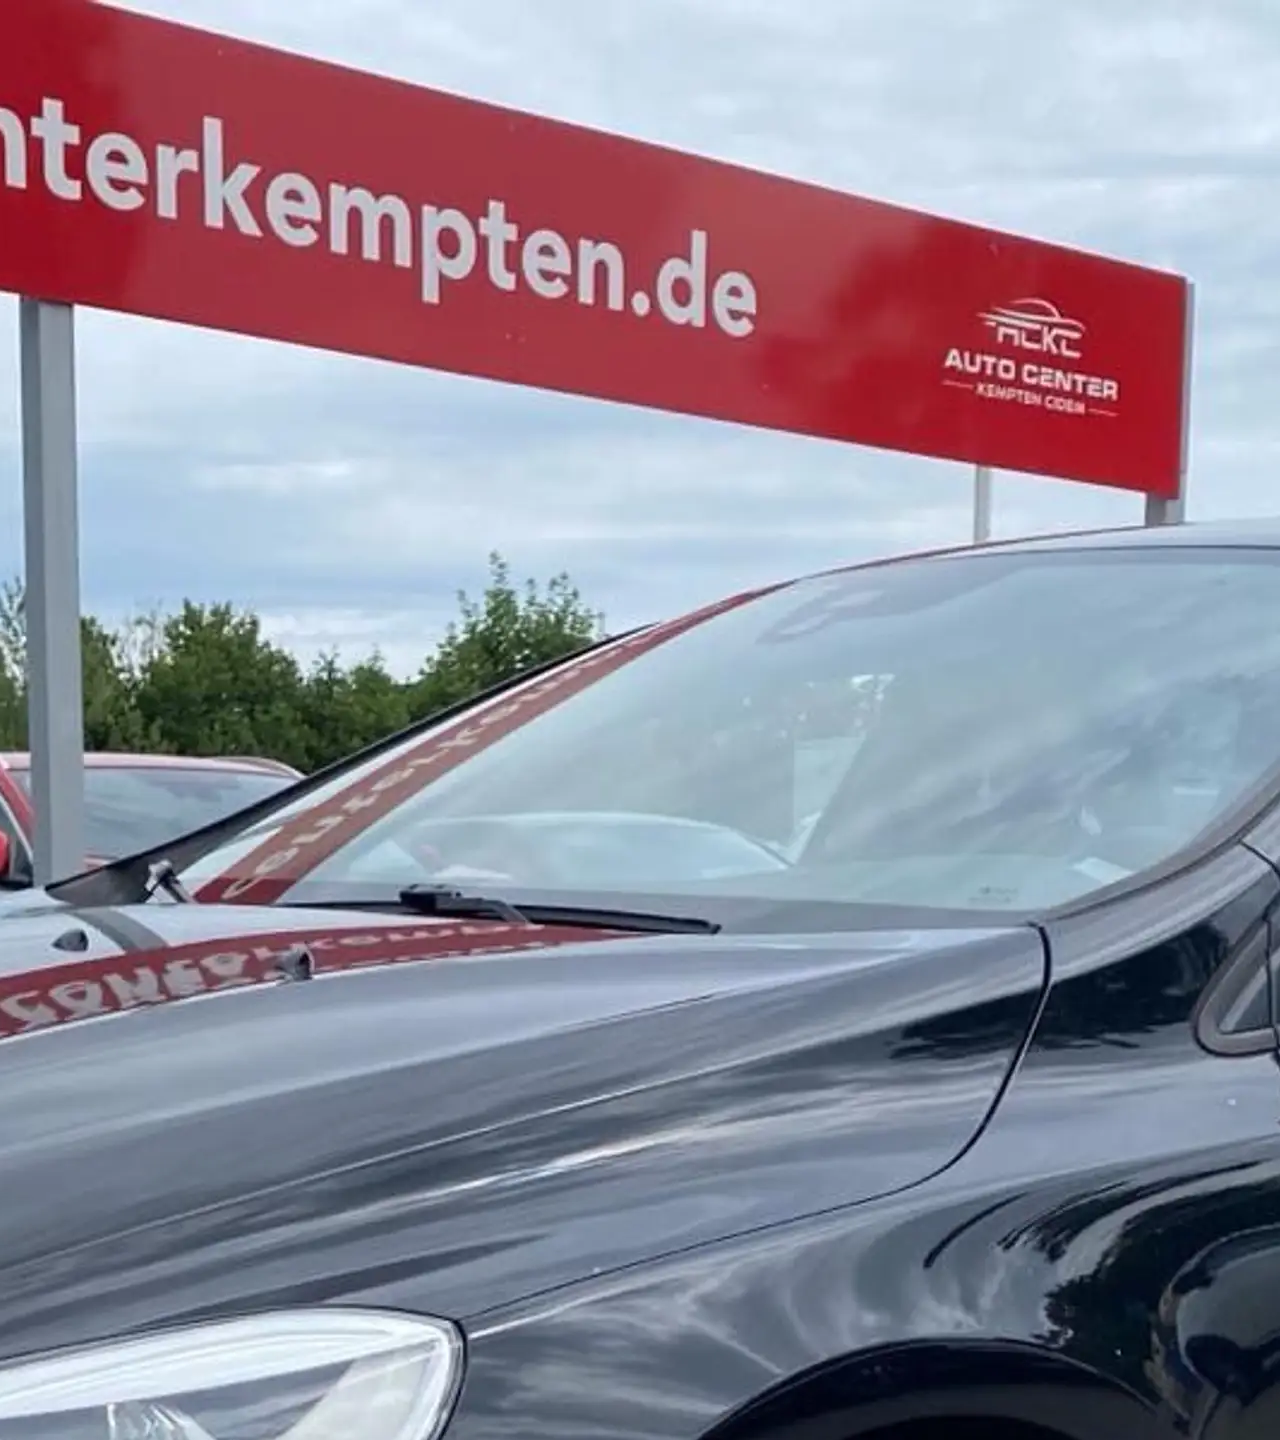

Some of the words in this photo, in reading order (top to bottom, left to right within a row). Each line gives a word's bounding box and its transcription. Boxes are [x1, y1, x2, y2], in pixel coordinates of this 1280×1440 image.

[943, 347, 1016, 381] AUTO
[1022, 362, 1119, 401] CENTER
[975, 382, 1042, 407] KEMPTEN
